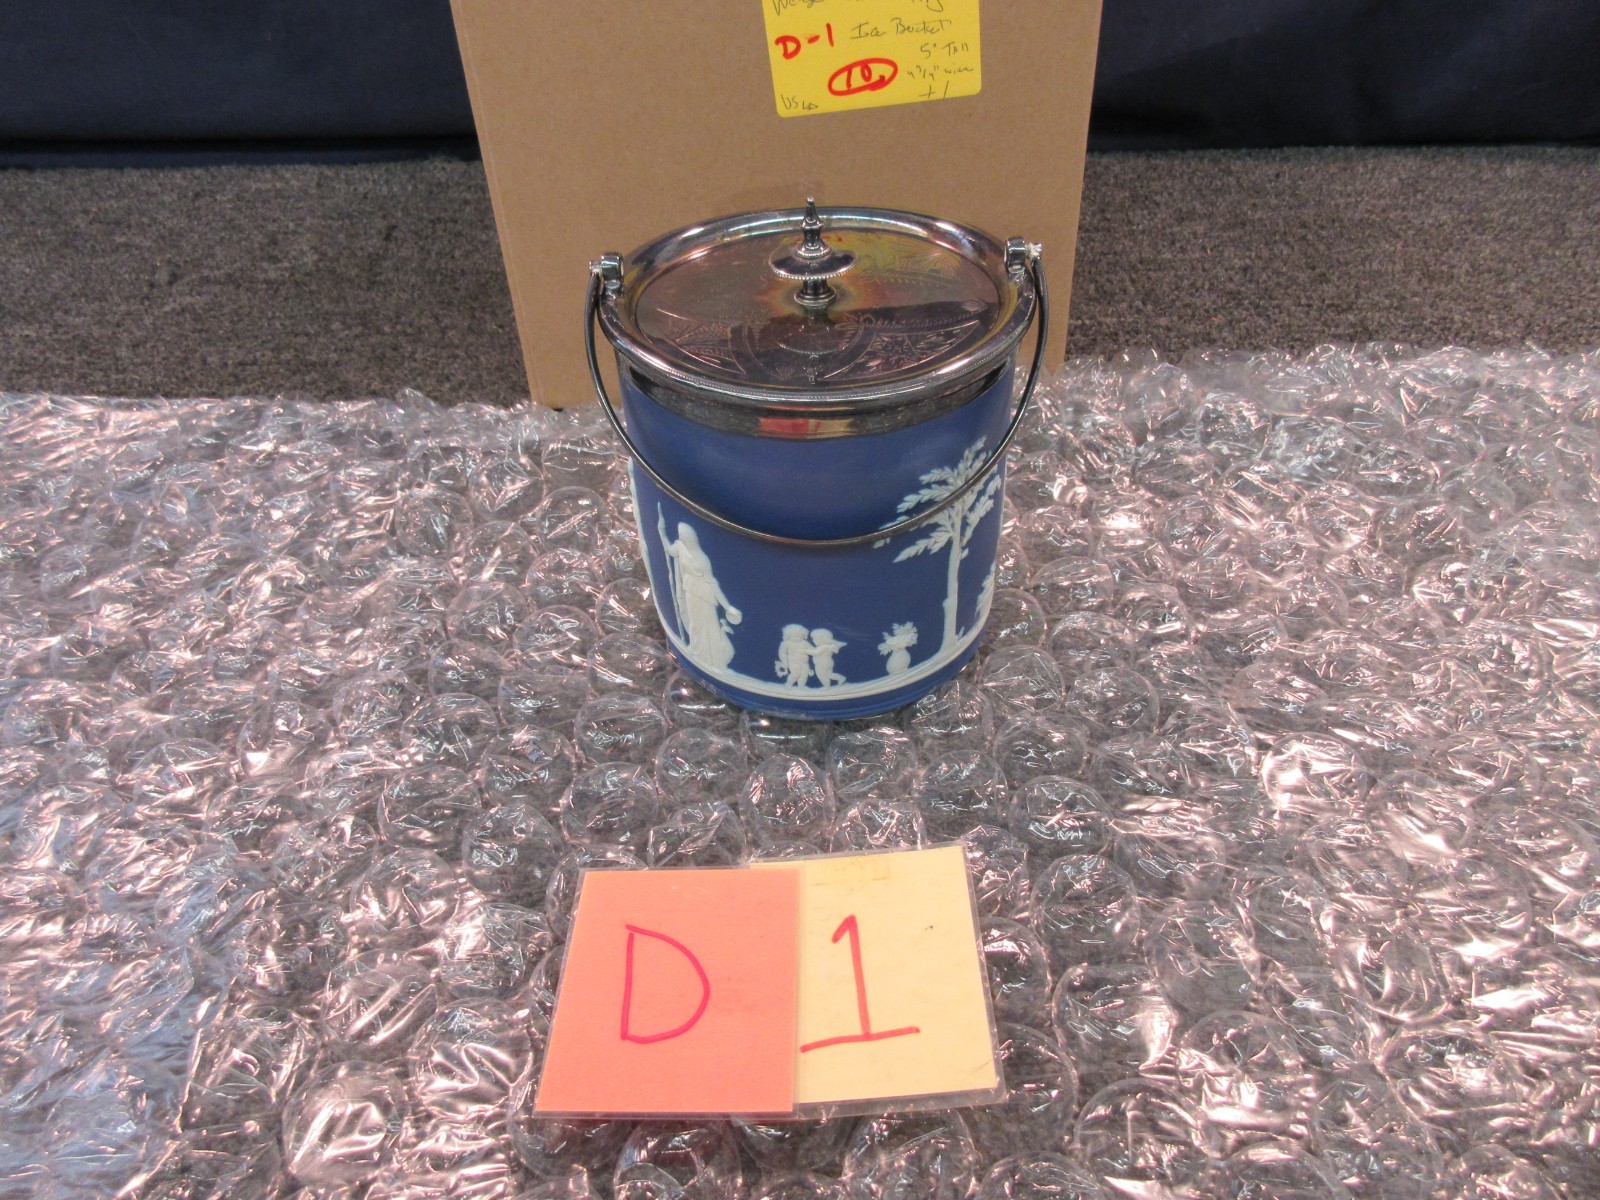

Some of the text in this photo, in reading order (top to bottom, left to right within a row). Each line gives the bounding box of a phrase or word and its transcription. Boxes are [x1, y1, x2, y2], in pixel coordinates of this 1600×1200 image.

[775, 22, 835, 60] D-1
[621, 914, 921, 1052] D 1
